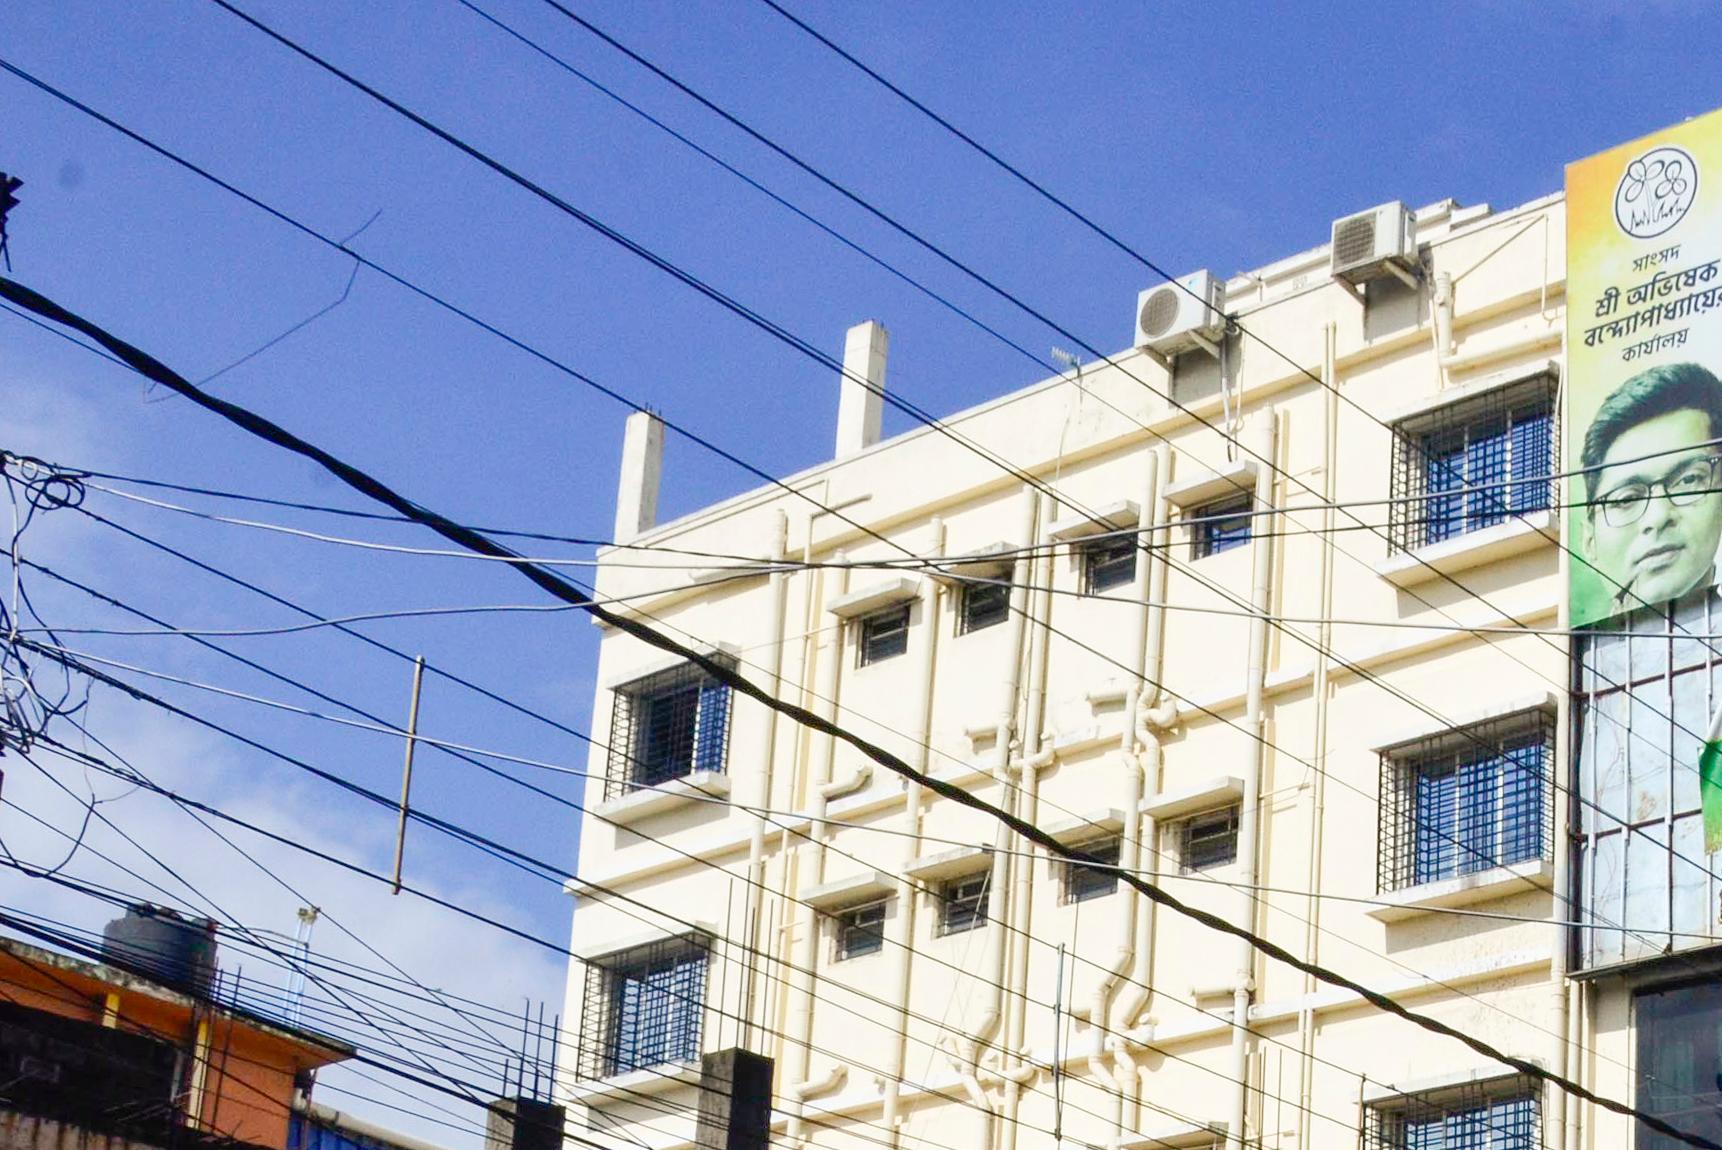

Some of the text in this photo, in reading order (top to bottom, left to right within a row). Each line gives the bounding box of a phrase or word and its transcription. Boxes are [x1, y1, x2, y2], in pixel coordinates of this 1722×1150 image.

[1632, 244, 1681, 272] সাংসদ
[1595, 259, 1721, 318] শ্রী অভিষেক
[1622, 328, 1690, 362] কার্যালয়
